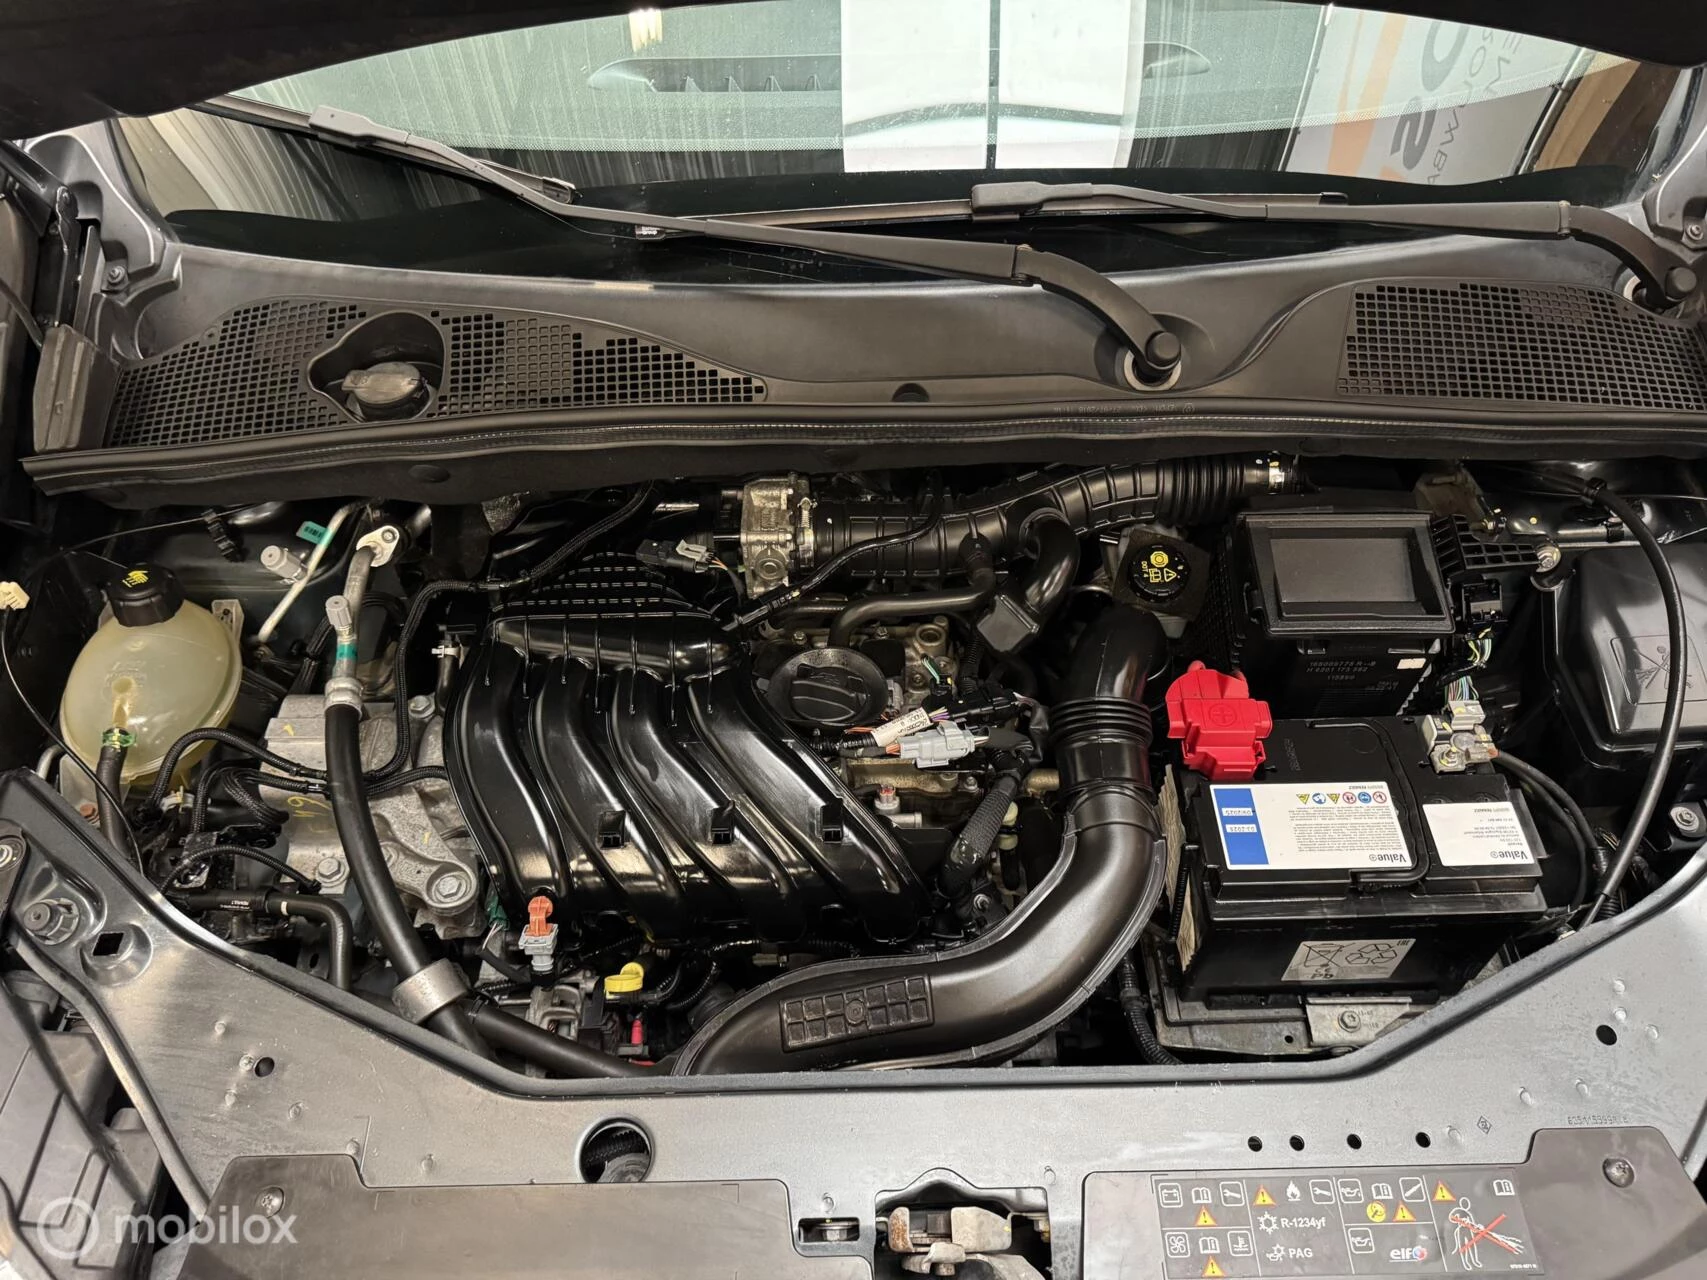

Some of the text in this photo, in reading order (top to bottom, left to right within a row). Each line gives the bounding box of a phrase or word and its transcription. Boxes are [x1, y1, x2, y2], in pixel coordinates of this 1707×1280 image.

[1280, 1216, 1326, 1229] R-1234yf
[1288, 1247, 1314, 1258] PAG
[1389, 1247, 1413, 1260] elf
